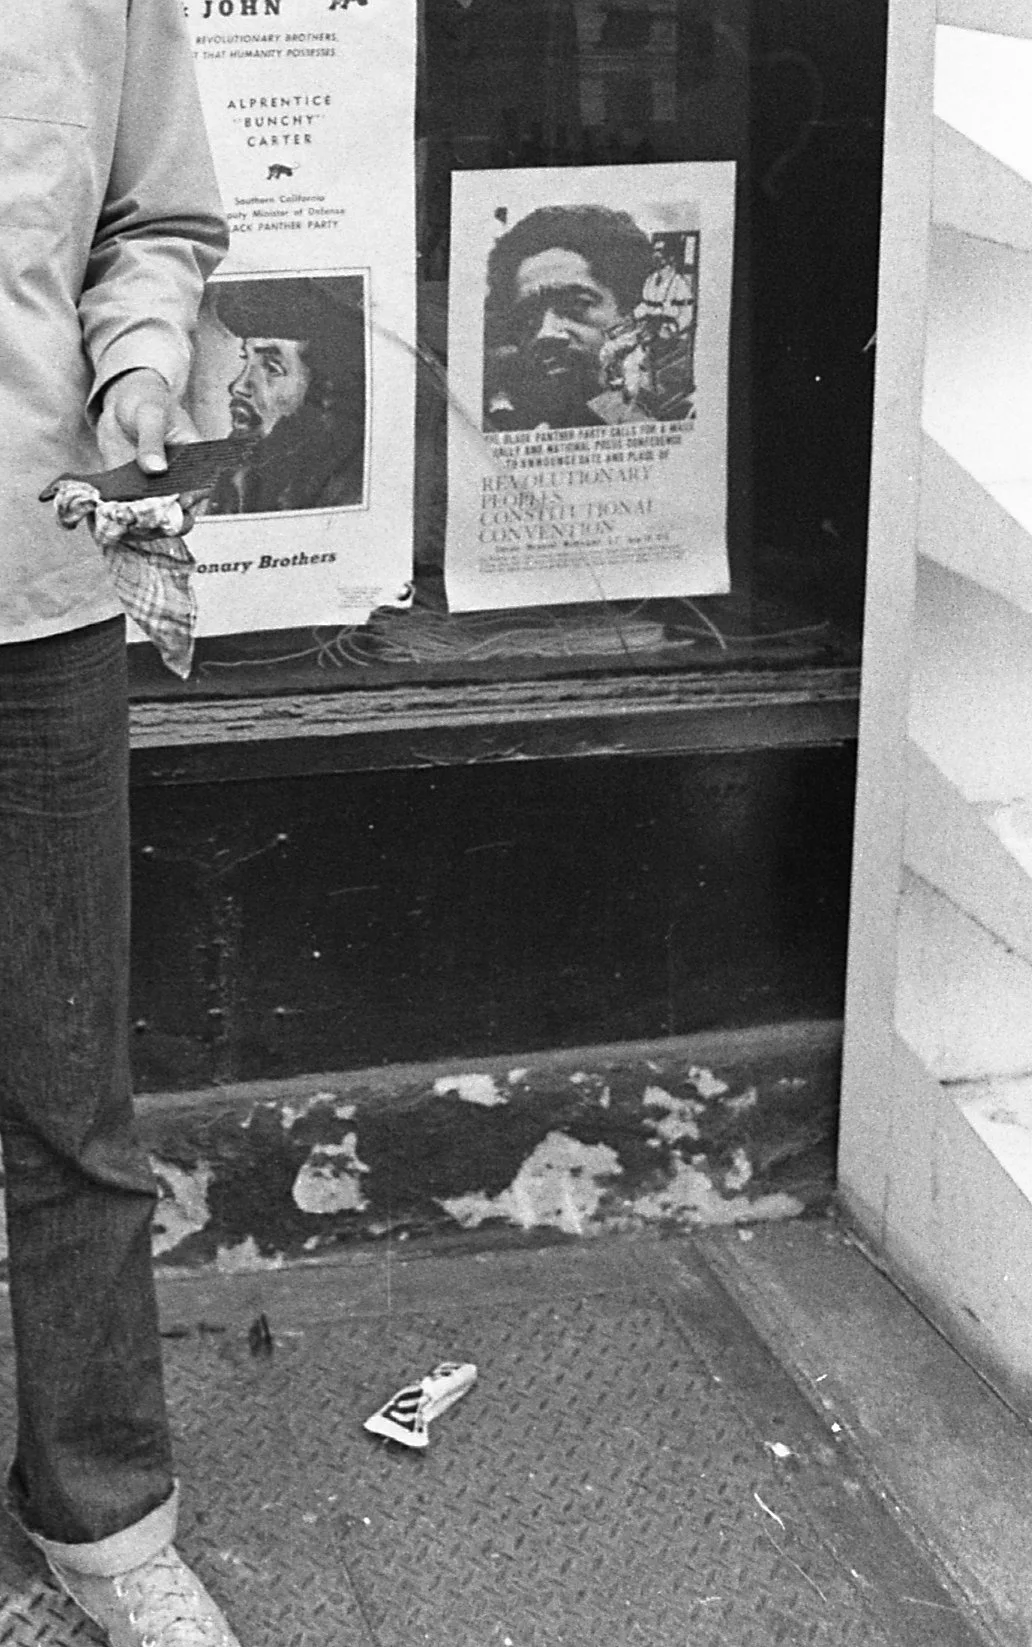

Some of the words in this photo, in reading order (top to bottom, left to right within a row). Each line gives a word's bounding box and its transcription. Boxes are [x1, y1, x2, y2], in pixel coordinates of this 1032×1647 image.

[195, 34, 281, 45] REVOLUTIONARY
[203, 51, 227, 60] THAT
[229, 49, 282, 59] HUMANITY
[286, 48, 336, 58] POSSESSES
[227, 95, 332, 110] ALPRENTICE
[247, 133, 313, 148] CARTER
[234, 196, 276, 206] Southern
[279, 194, 326, 204] California
[252, 209, 290, 219] Minister
[294, 208, 304, 217] of
[308, 206, 346, 217] Defense
[258, 221, 302, 232] PANTHER
[307, 220, 339, 230] PARTY
[535, 430, 575, 443] PANTHER
[482, 466, 653, 492] REVOLUTIONARY
[482, 491, 563, 510] PEOPLES
[479, 499, 652, 526] CONSTITUTIONAL
[478, 521, 613, 543] CONVENTION
[257, 551, 338, 570] Brothers
